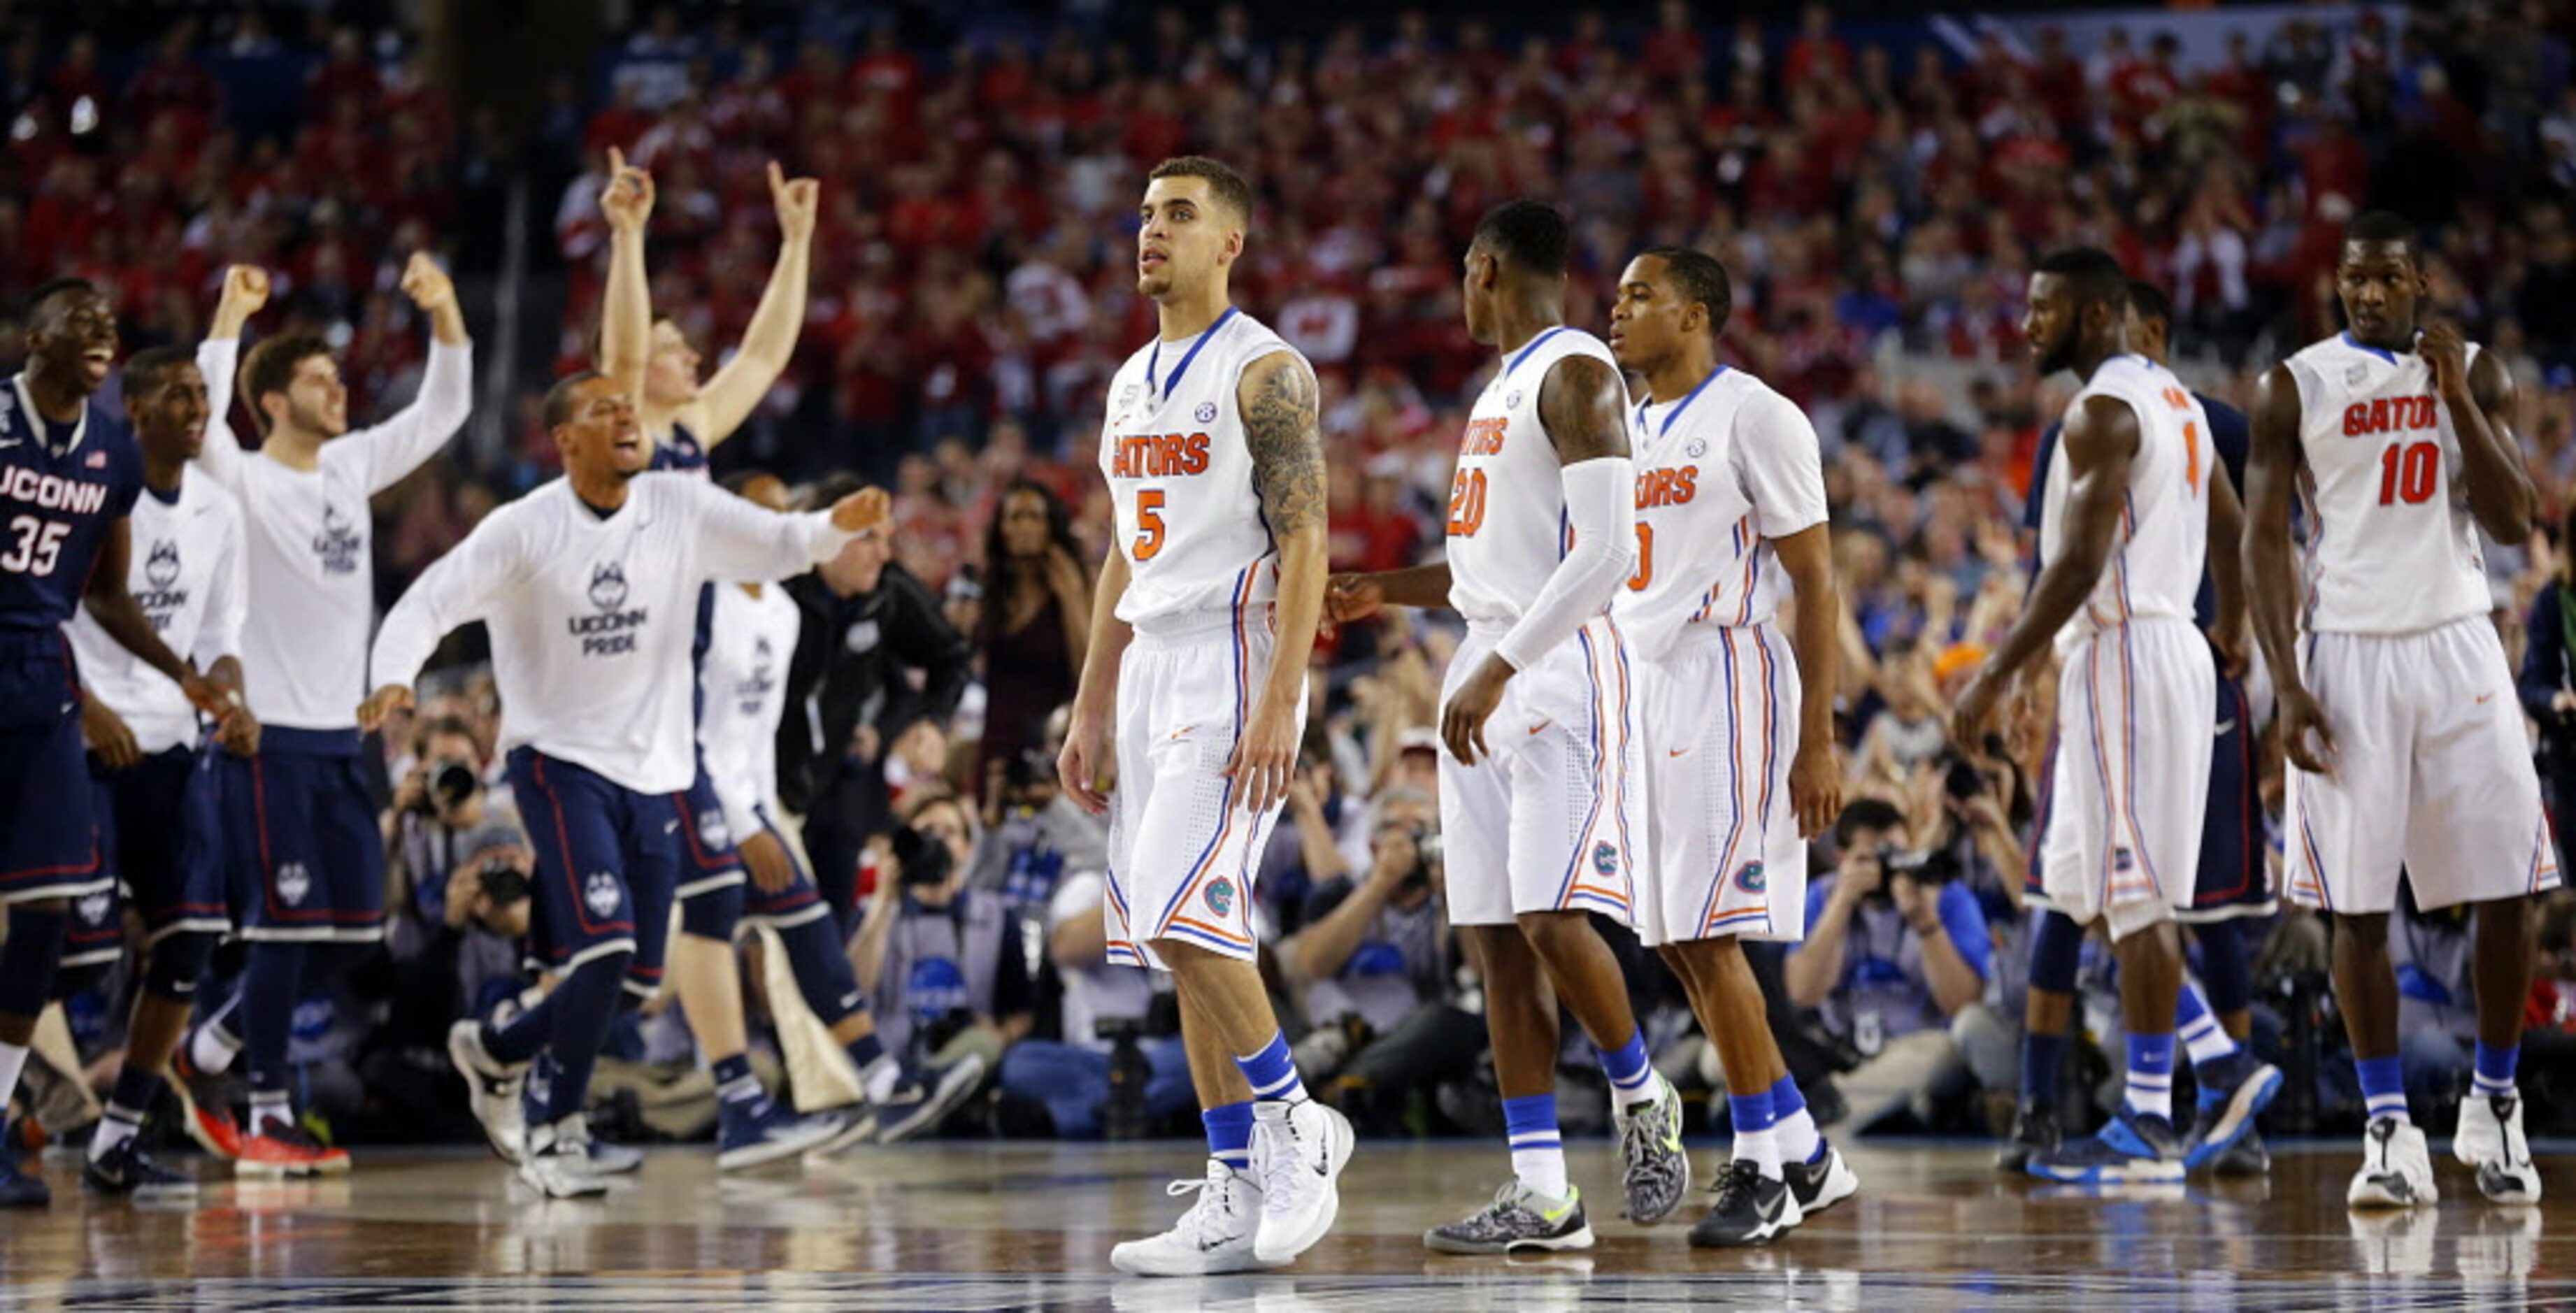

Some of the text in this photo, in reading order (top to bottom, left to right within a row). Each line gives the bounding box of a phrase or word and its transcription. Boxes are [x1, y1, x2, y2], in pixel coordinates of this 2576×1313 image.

[1446, 467, 1487, 538] 20
[2379, 440, 2440, 507] 10
[0, 514, 72, 577] 35
[1131, 487, 1166, 562] 5
